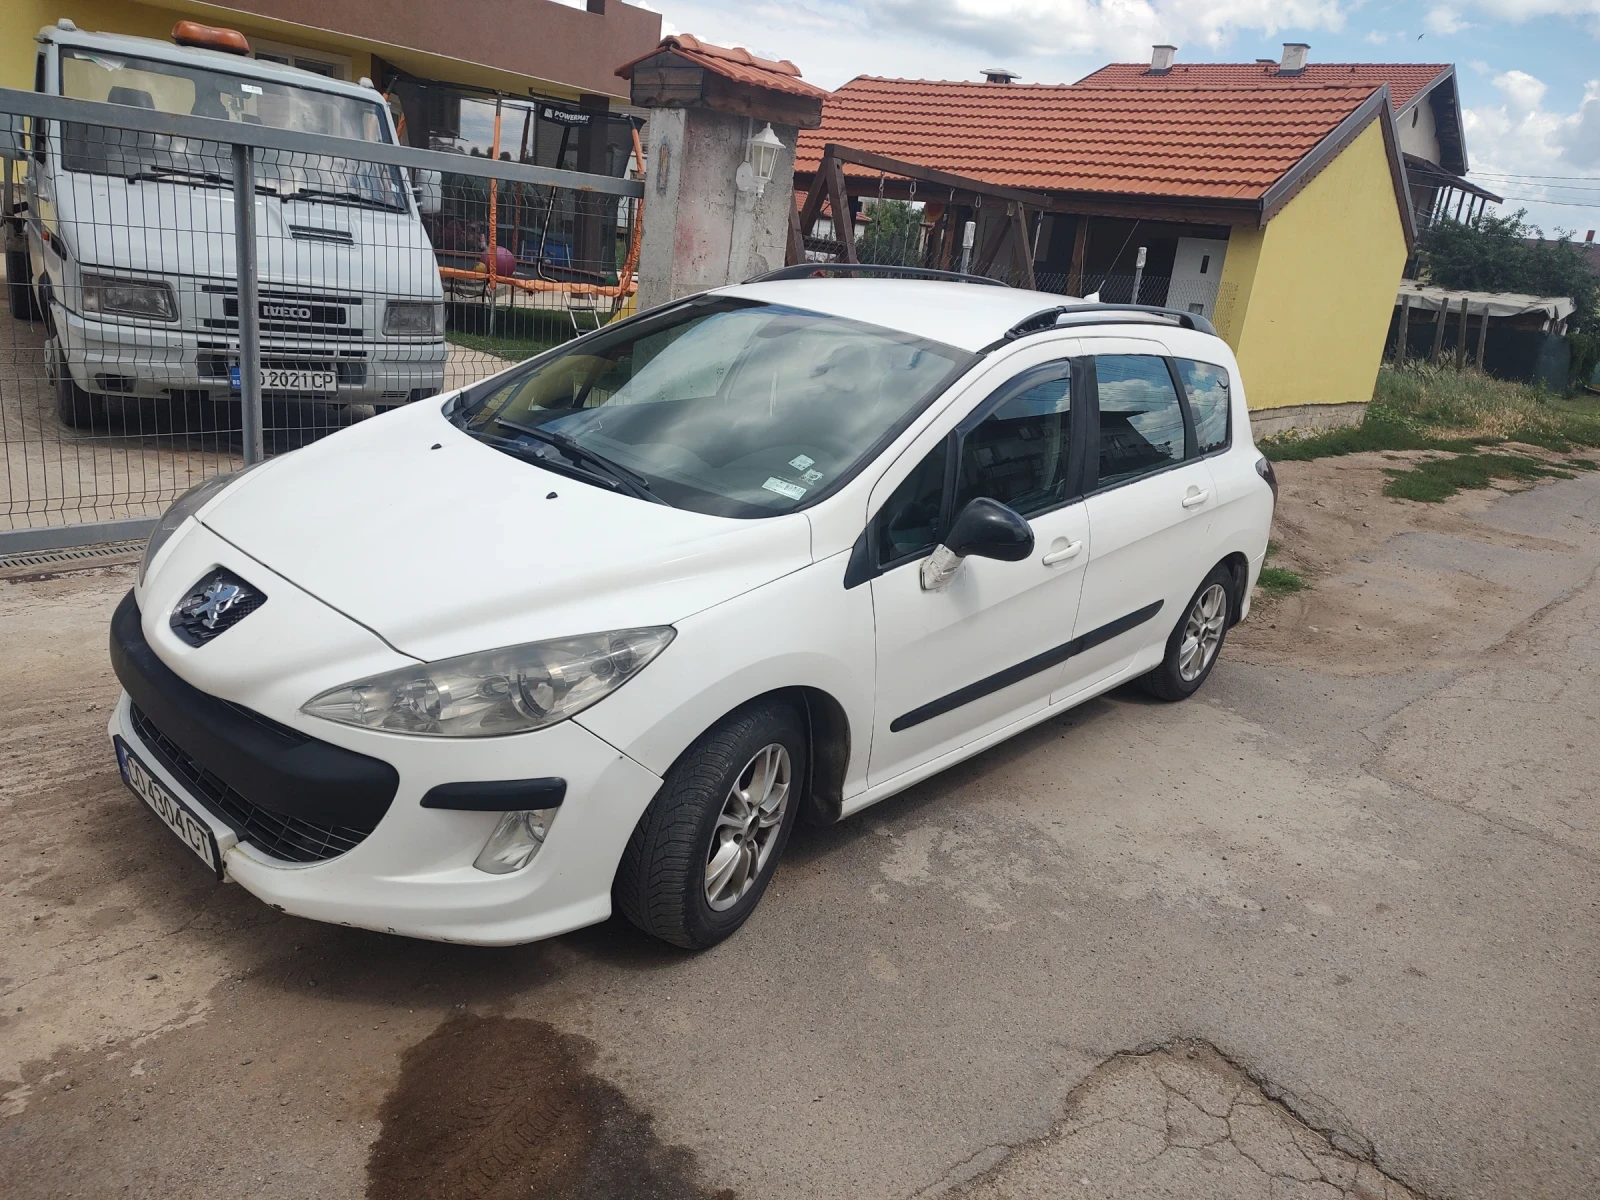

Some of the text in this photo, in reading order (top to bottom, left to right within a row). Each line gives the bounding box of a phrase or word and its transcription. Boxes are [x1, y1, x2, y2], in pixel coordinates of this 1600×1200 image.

[554, 110, 590, 121] POWERMAT
[263, 305, 311, 319] IVECO
[269, 371, 308, 388] 2021
[312, 373, 333, 389] CP
[127, 756, 209, 860] CO 4304 CT
